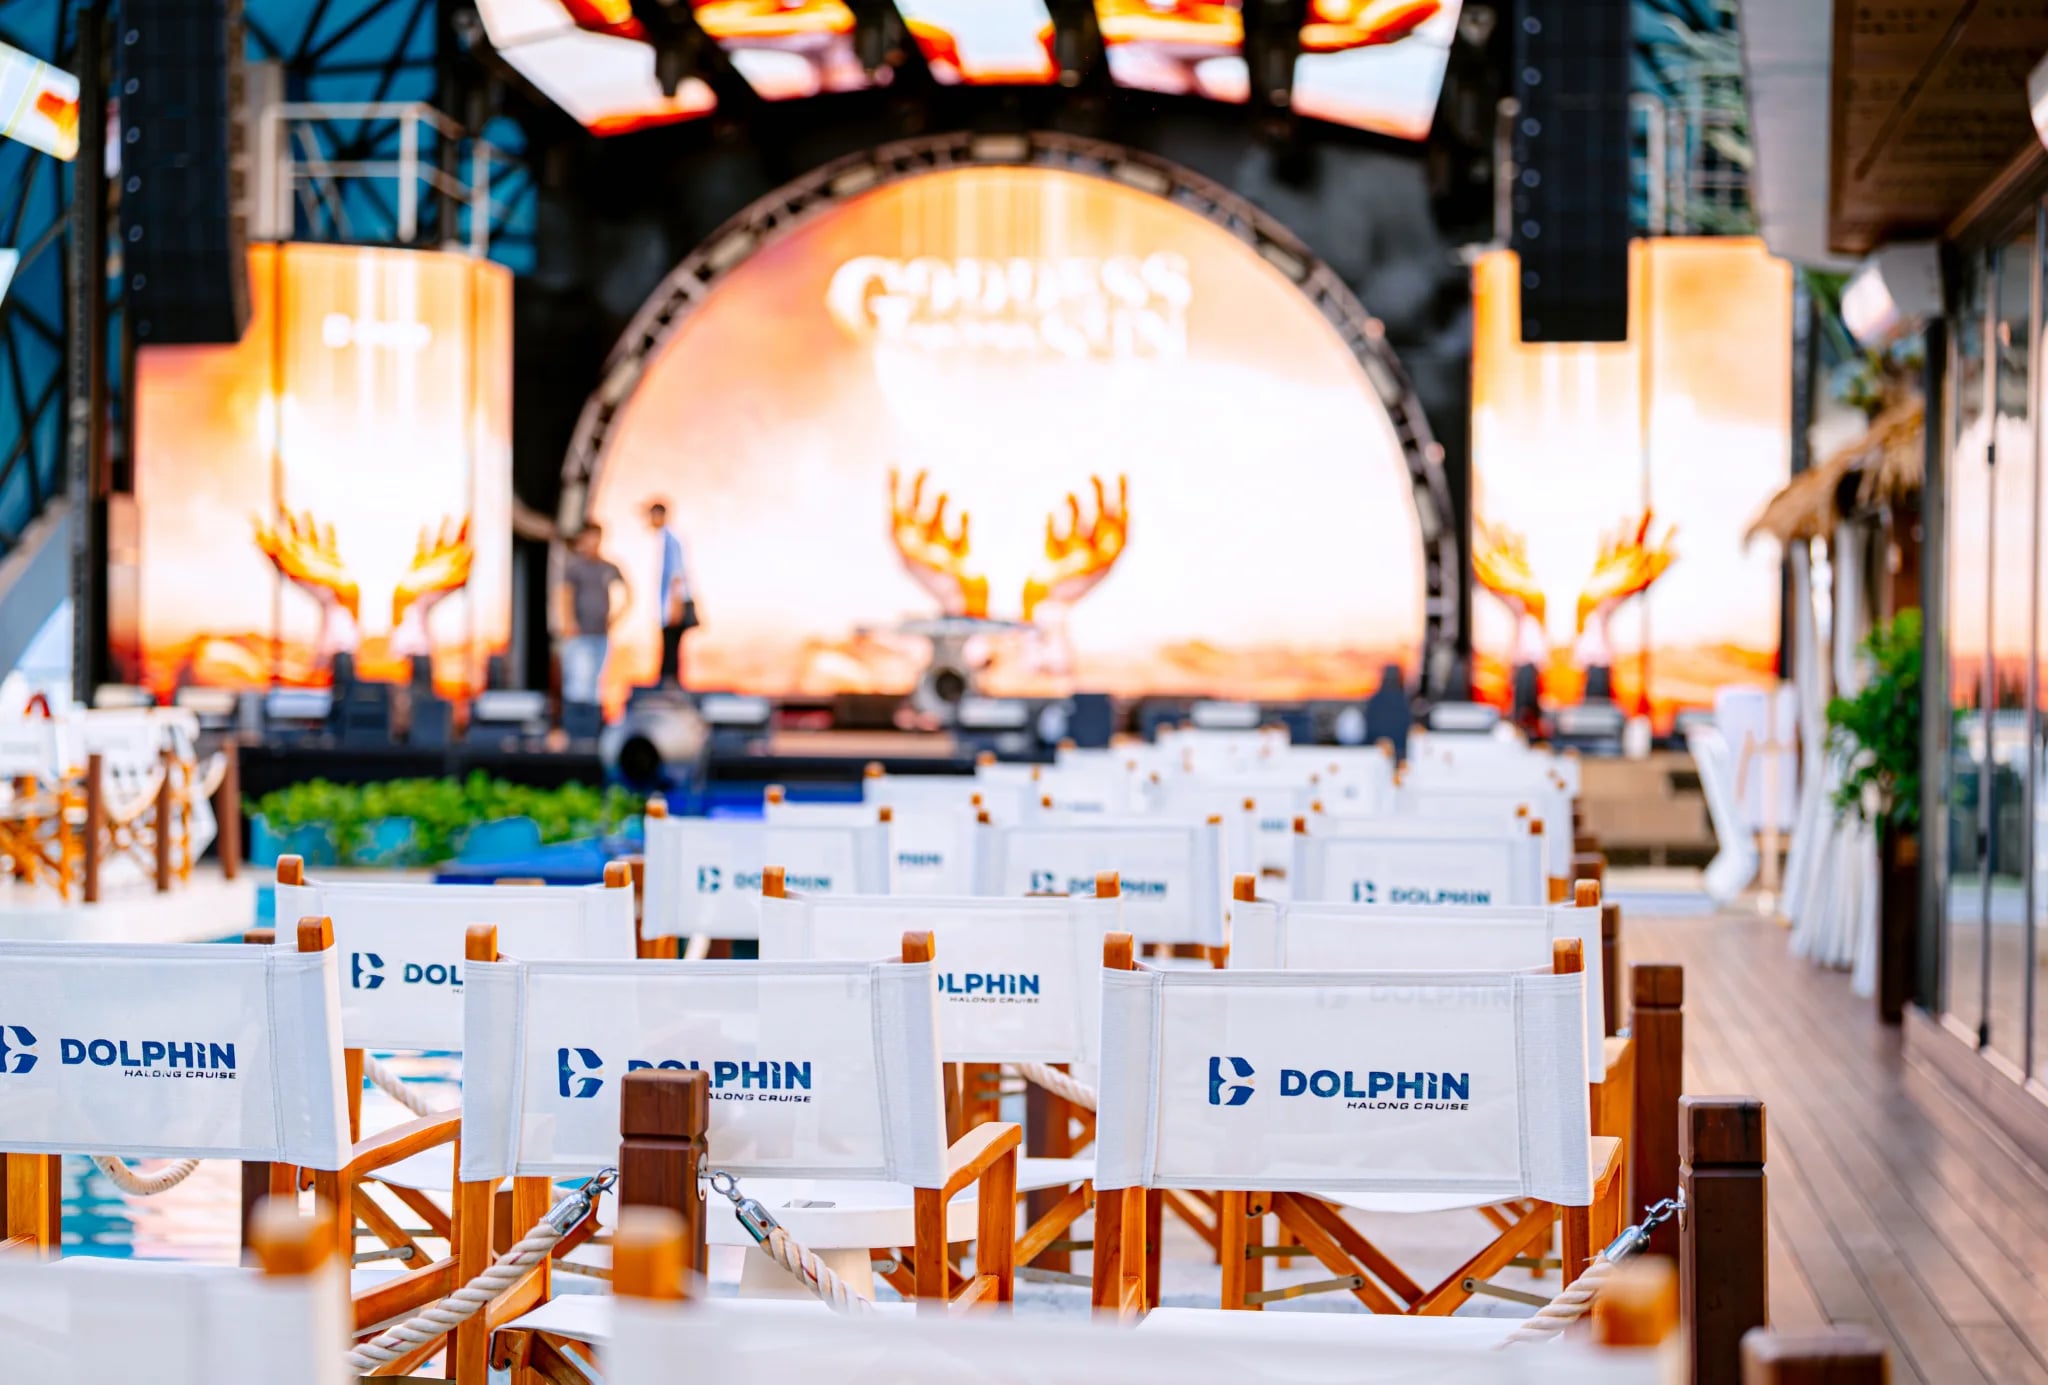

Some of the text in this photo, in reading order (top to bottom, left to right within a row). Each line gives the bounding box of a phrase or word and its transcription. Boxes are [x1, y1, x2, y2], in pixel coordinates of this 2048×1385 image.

[938, 973, 1040, 995] LPHIN
[60, 1038, 236, 1069] DOLPHIN
[124, 1069, 237, 1080] HALONG CRUISE
[1280, 1069, 1469, 1100] DOLPHIN
[707, 1092, 812, 1103] ALONG CRUISE
[1347, 1101, 1469, 1110] HALONG CRUISE
